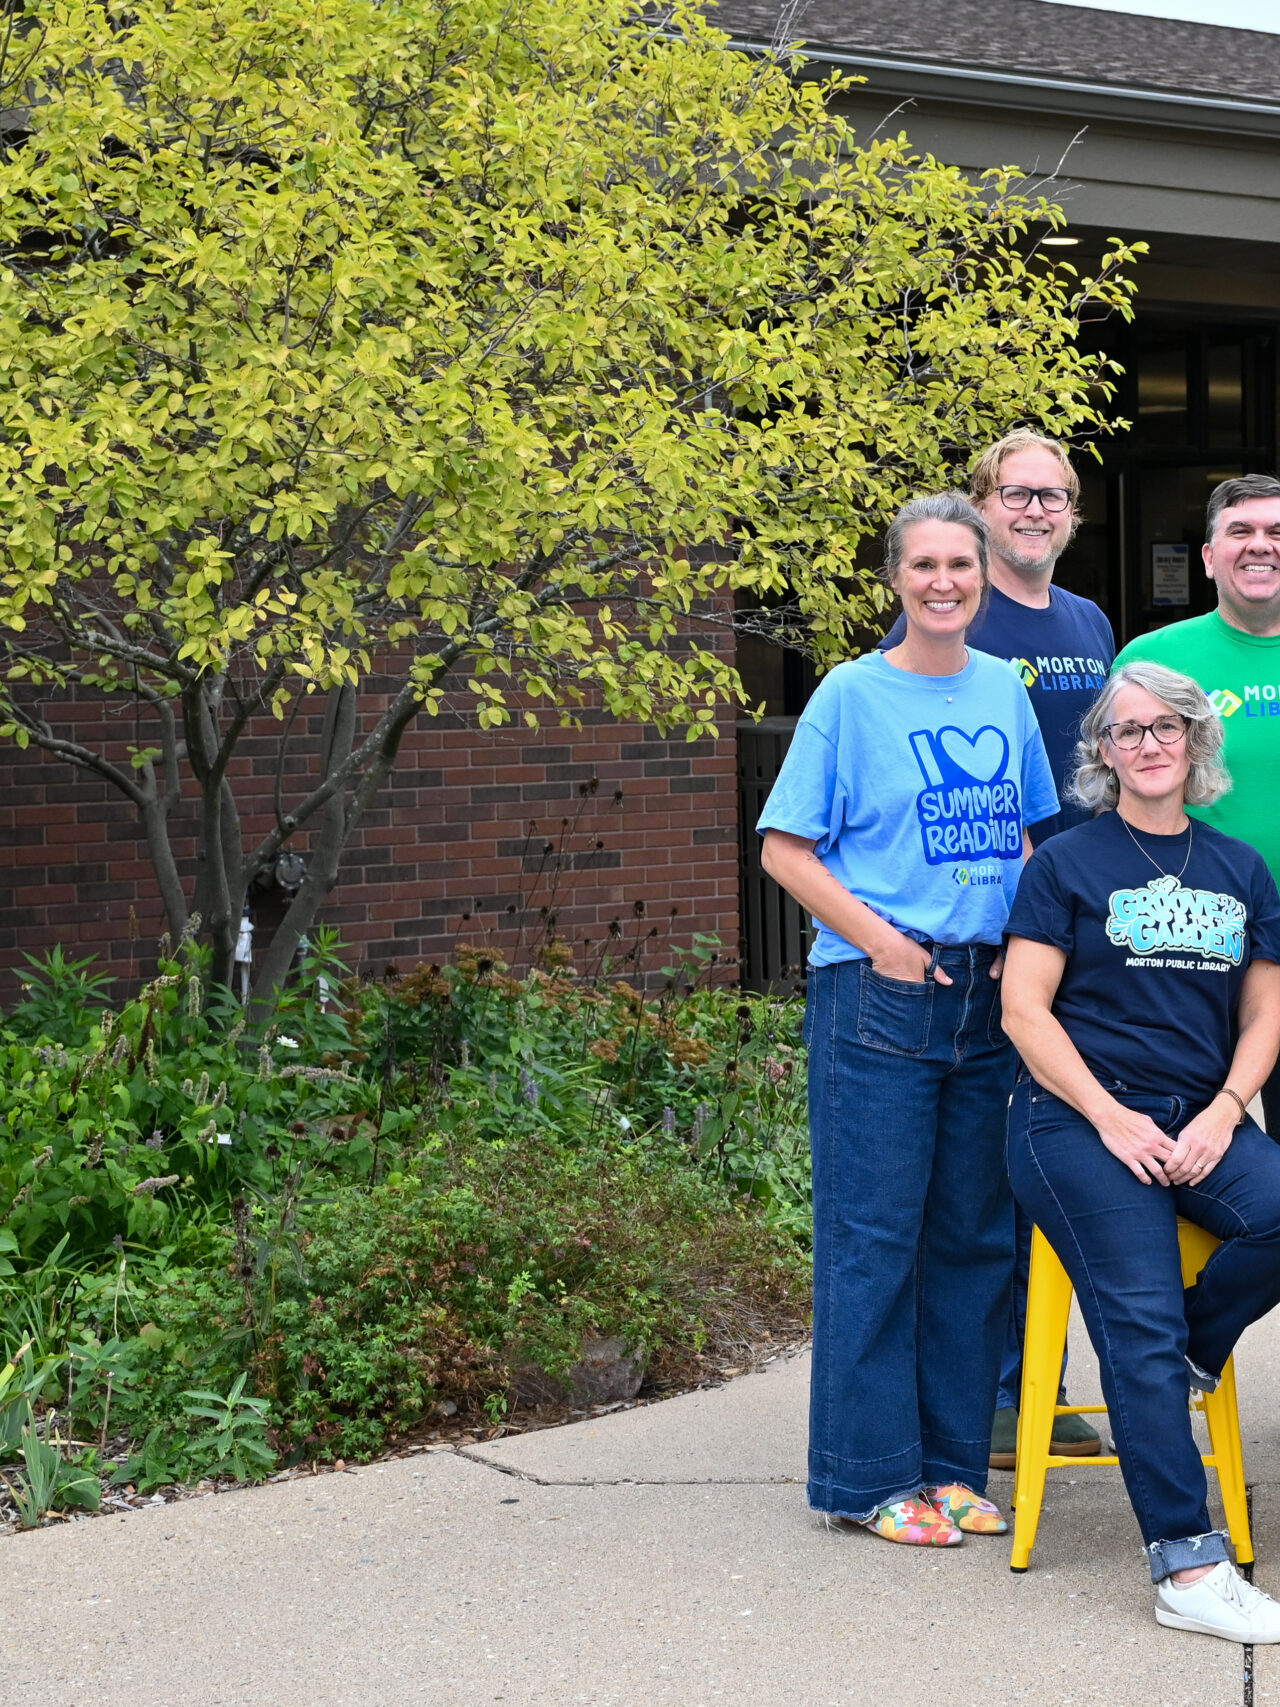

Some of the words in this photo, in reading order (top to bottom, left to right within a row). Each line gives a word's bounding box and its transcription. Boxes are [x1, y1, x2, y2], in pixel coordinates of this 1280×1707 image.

[1036, 656, 1106, 676] MORTON
[1040, 674, 1104, 690] LIBRAR
[911, 731, 945, 787] I
[1112, 890, 1223, 922] GROOVE
[1131, 915, 1241, 961] GARDEN
[1126, 957, 1164, 968] MORTON
[1165, 959, 1195, 970] PUBLIC
[1197, 961, 1231, 973] LIBRARY
